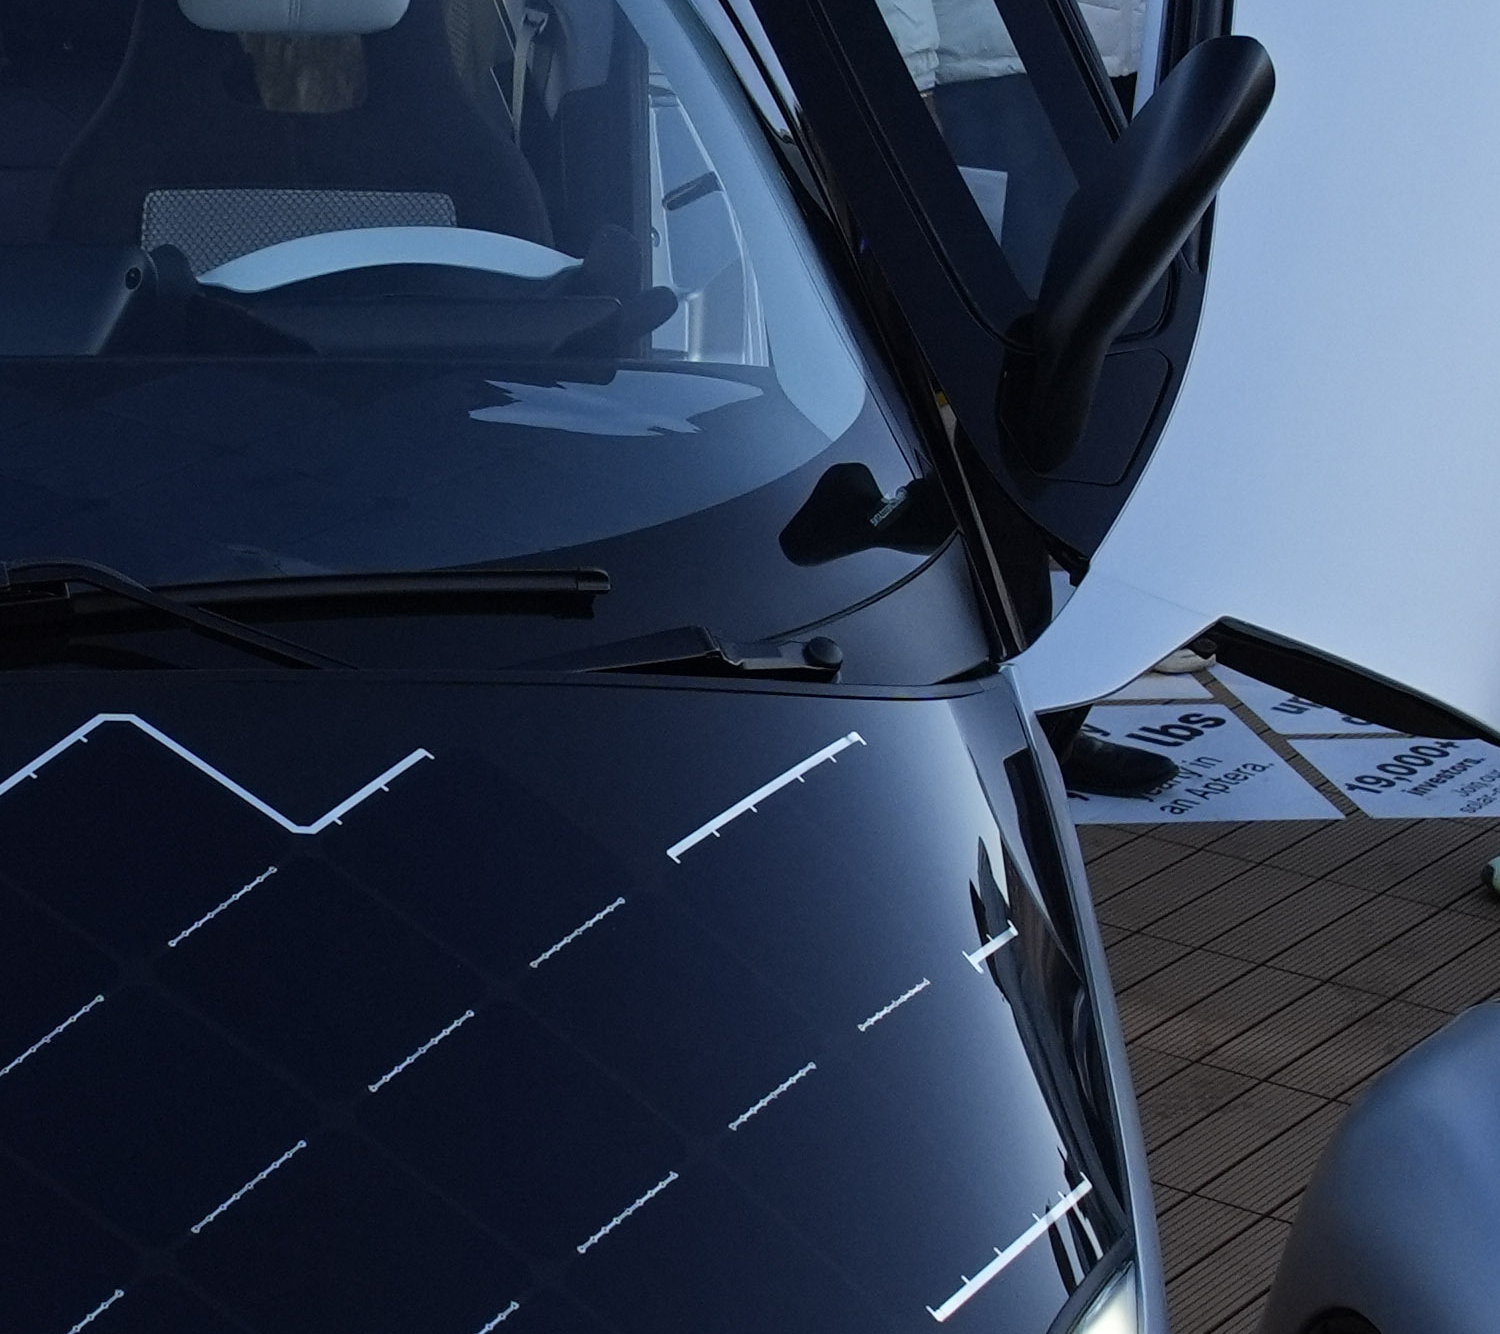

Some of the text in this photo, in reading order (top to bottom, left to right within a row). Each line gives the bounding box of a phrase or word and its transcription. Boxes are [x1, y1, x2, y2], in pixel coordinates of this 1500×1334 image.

[1125, 713, 1227, 747] lbs
[1159, 758, 1275, 816] an Aptera.
[1345, 740, 1460, 795] 19,000+
[1401, 755, 1488, 797] investors.
[1452, 777, 1485, 798] Join
